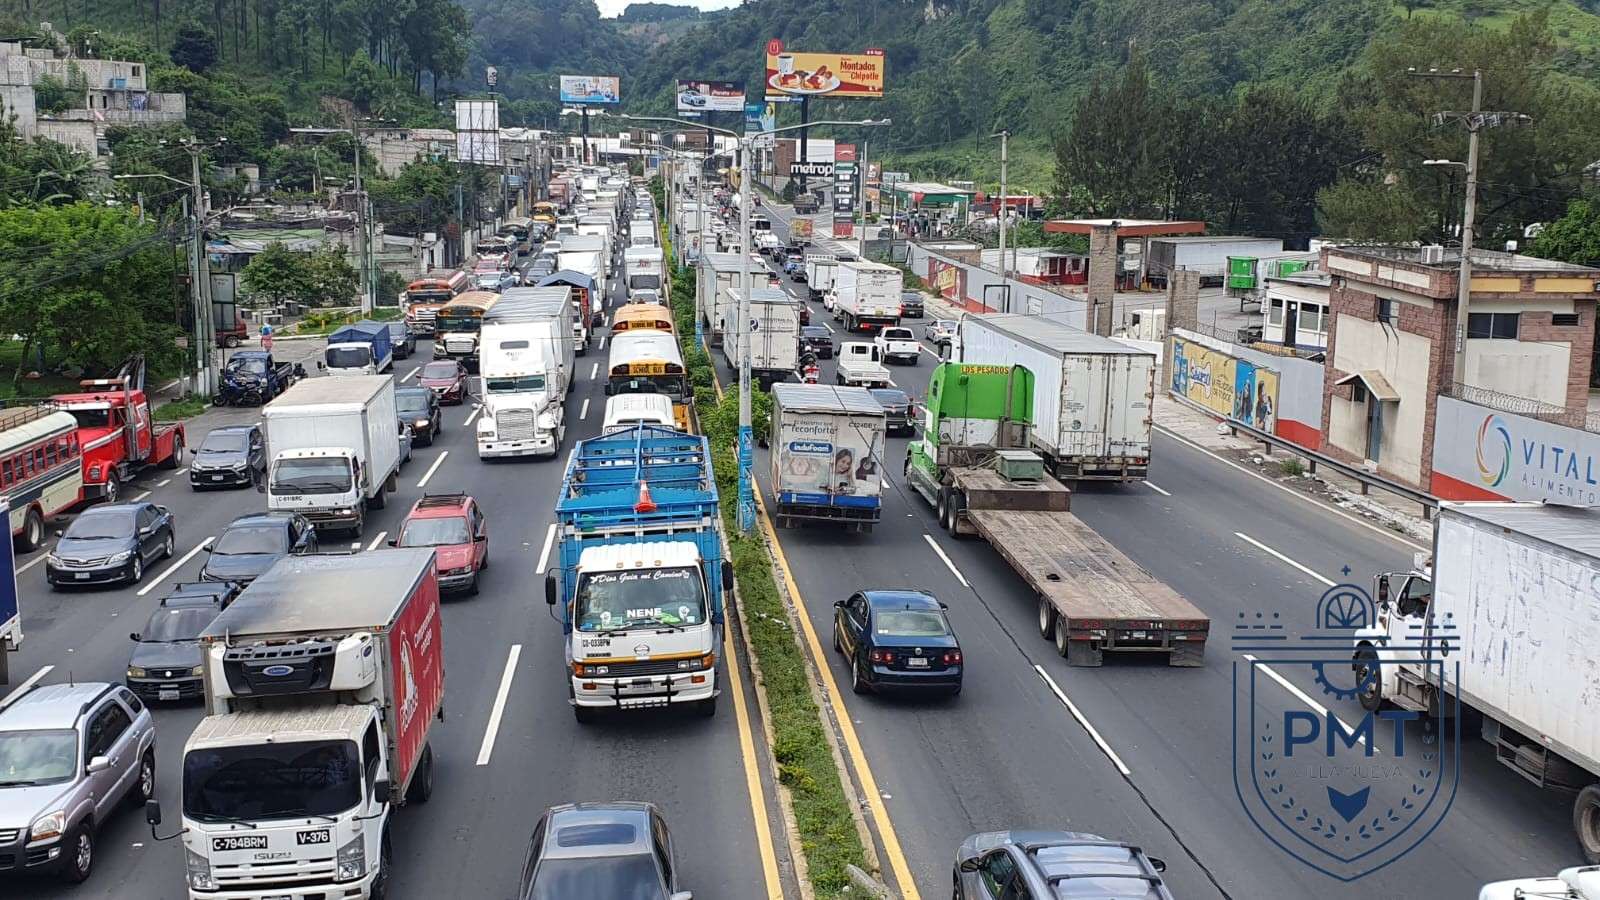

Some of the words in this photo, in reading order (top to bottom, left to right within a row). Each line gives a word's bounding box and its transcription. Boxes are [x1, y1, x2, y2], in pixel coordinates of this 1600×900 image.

[840, 61, 876, 71] Montados
[632, 366, 650, 374] SCHOOL
[652, 366, 663, 374] BUS
[960, 366, 975, 375] LOS
[976, 366, 1010, 375] PESADOS
[1522, 438, 1598, 485] VITAL
[626, 607, 662, 618] NENE
[298, 830, 329, 844] V-376
[213, 836, 267, 850] C-794BRM
[253, 851, 292, 861] ISUZU
